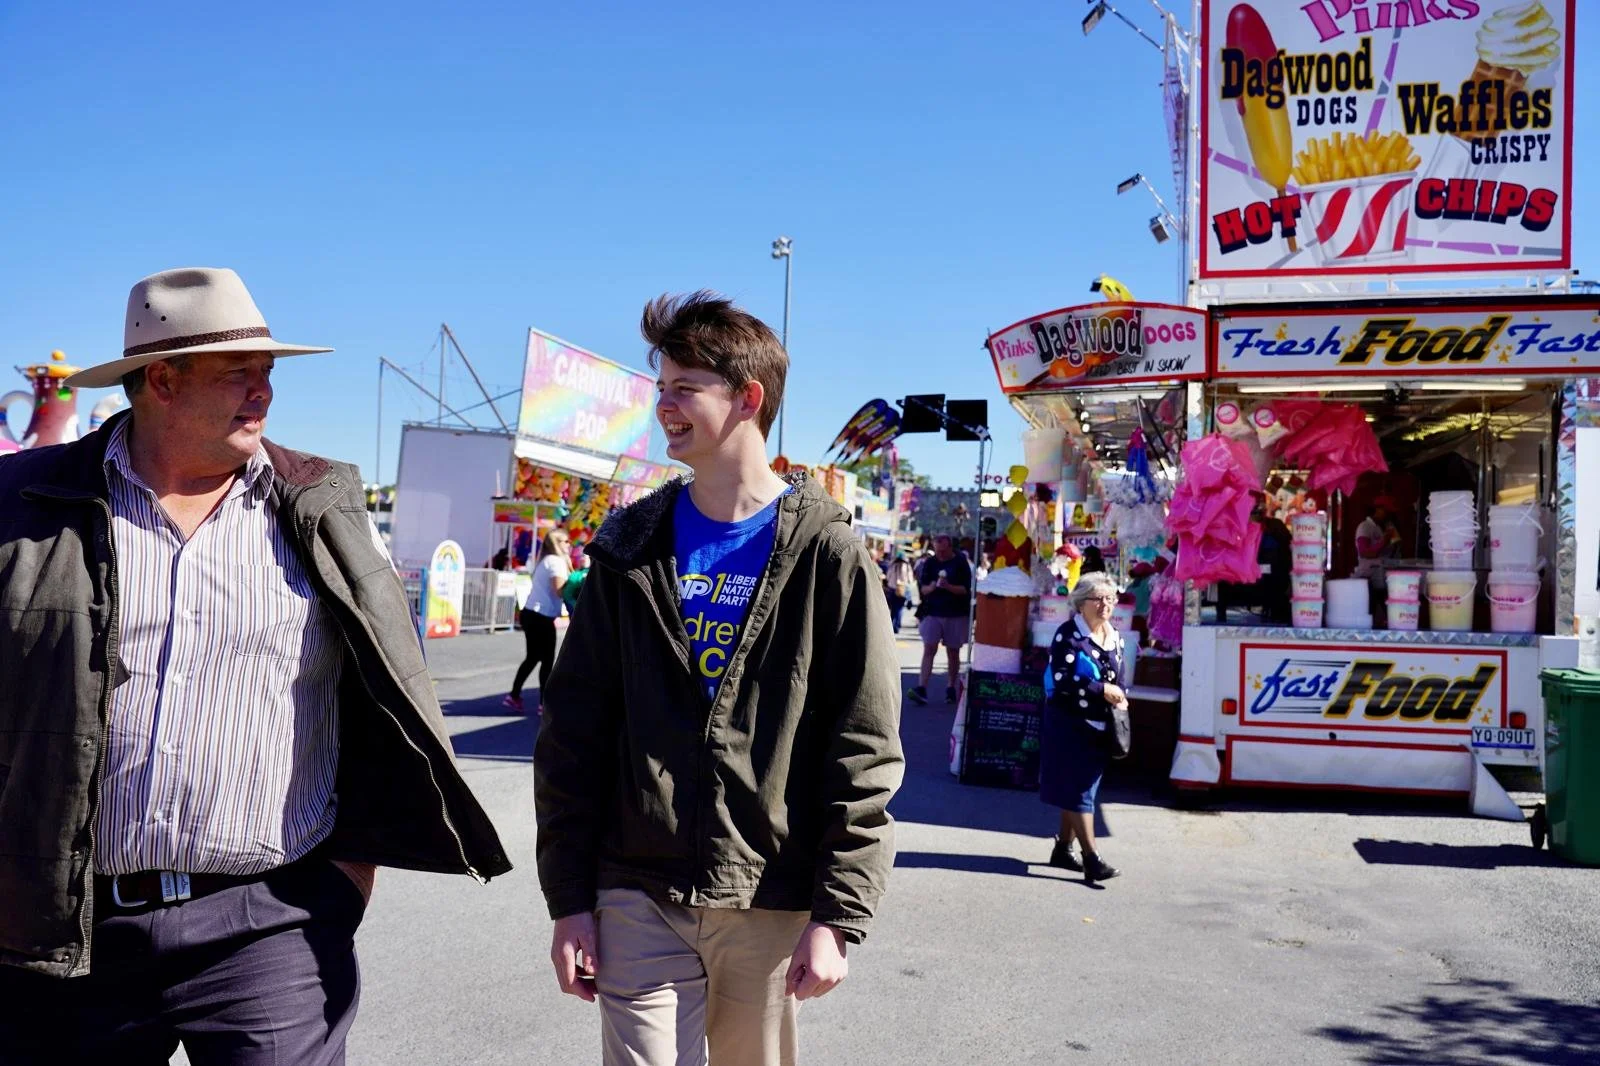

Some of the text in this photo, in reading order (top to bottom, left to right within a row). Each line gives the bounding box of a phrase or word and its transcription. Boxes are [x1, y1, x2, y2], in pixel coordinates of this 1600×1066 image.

[1221, 36, 1374, 110] Dagwood
[1297, 96, 1357, 126] DOGS
[1397, 79, 1553, 135] Waffles
[1470, 133, 1551, 165] CRISPY
[1212, 192, 1302, 256] HOT
[1415, 177, 1559, 232] CHIPS
[994, 308, 1197, 368] Pinks Dagwood DOGS
[1222, 313, 1600, 366] Fresh Food Fast
[554, 353, 632, 409] CARNIVAL
[1144, 359, 1154, 373] IN
[573, 408, 609, 442] POP
[710, 573, 727, 603] 1
[684, 611, 740, 645] dre
[698, 647, 726, 678] C
[1250, 658, 1500, 722] fast Food
